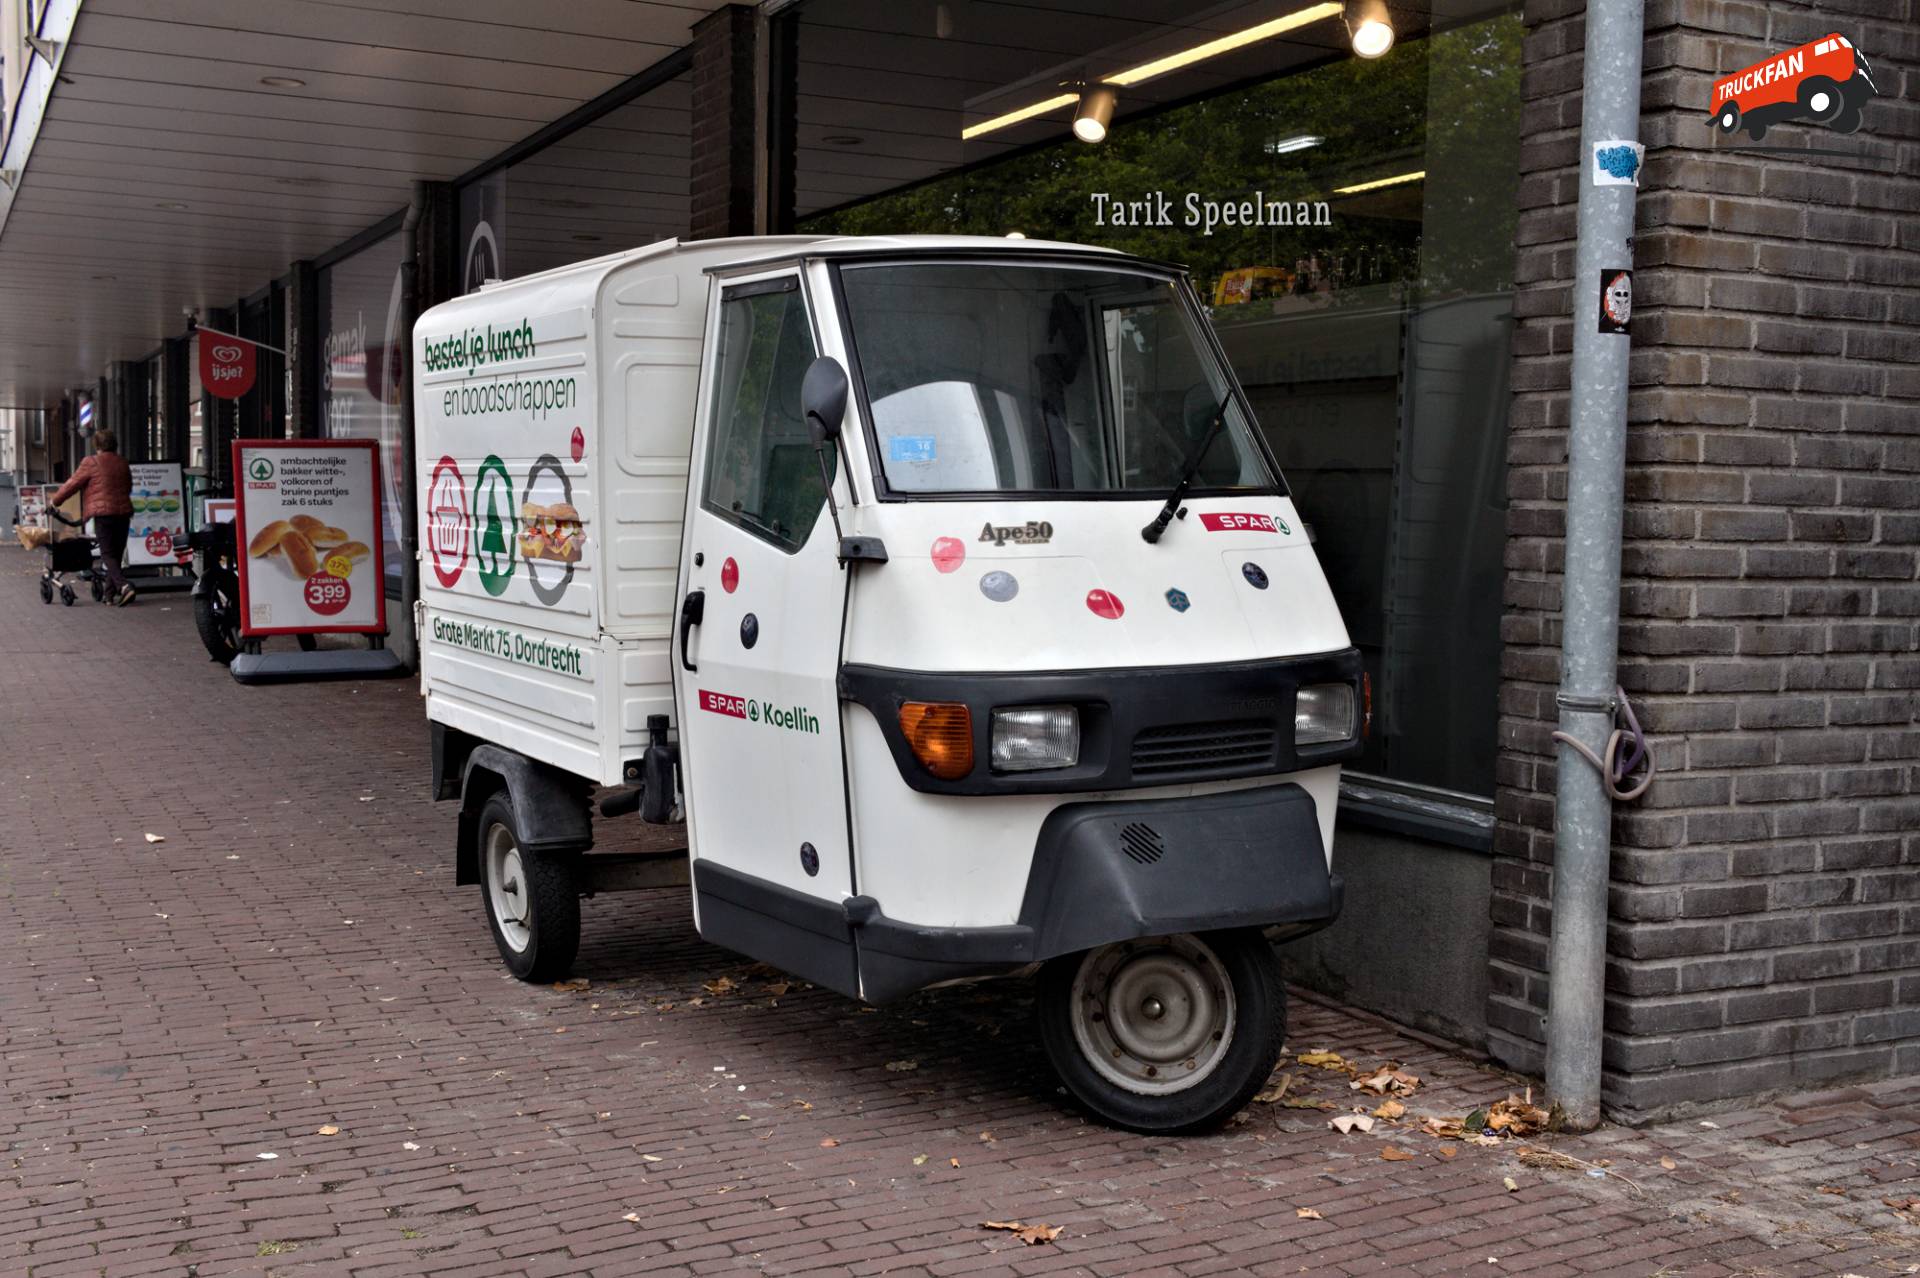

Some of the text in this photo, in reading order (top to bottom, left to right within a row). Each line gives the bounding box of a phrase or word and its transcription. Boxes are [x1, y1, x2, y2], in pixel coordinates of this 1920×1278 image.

[425, 318, 535, 376] bestel je lunch
[212, 363, 243, 381] ijsje?
[444, 373, 576, 420] en boodschappen
[324, 396, 353, 439] voor
[280, 456, 347, 467] ambachtelijke
[280, 467, 346, 476] bakker witte-,
[281, 477, 334, 486] volkoren of
[281, 487, 349, 497] bruine puntjes
[281, 497, 334, 506] zak 6 stuks
[1219, 514, 1276, 530] SPAR
[978, 521, 1054, 547] Ape50
[309, 584, 346, 604] 3.99
[433, 616, 582, 676] Grote Markt 75, Dordrecht
[708, 694, 820, 735] SPAR Koellin
